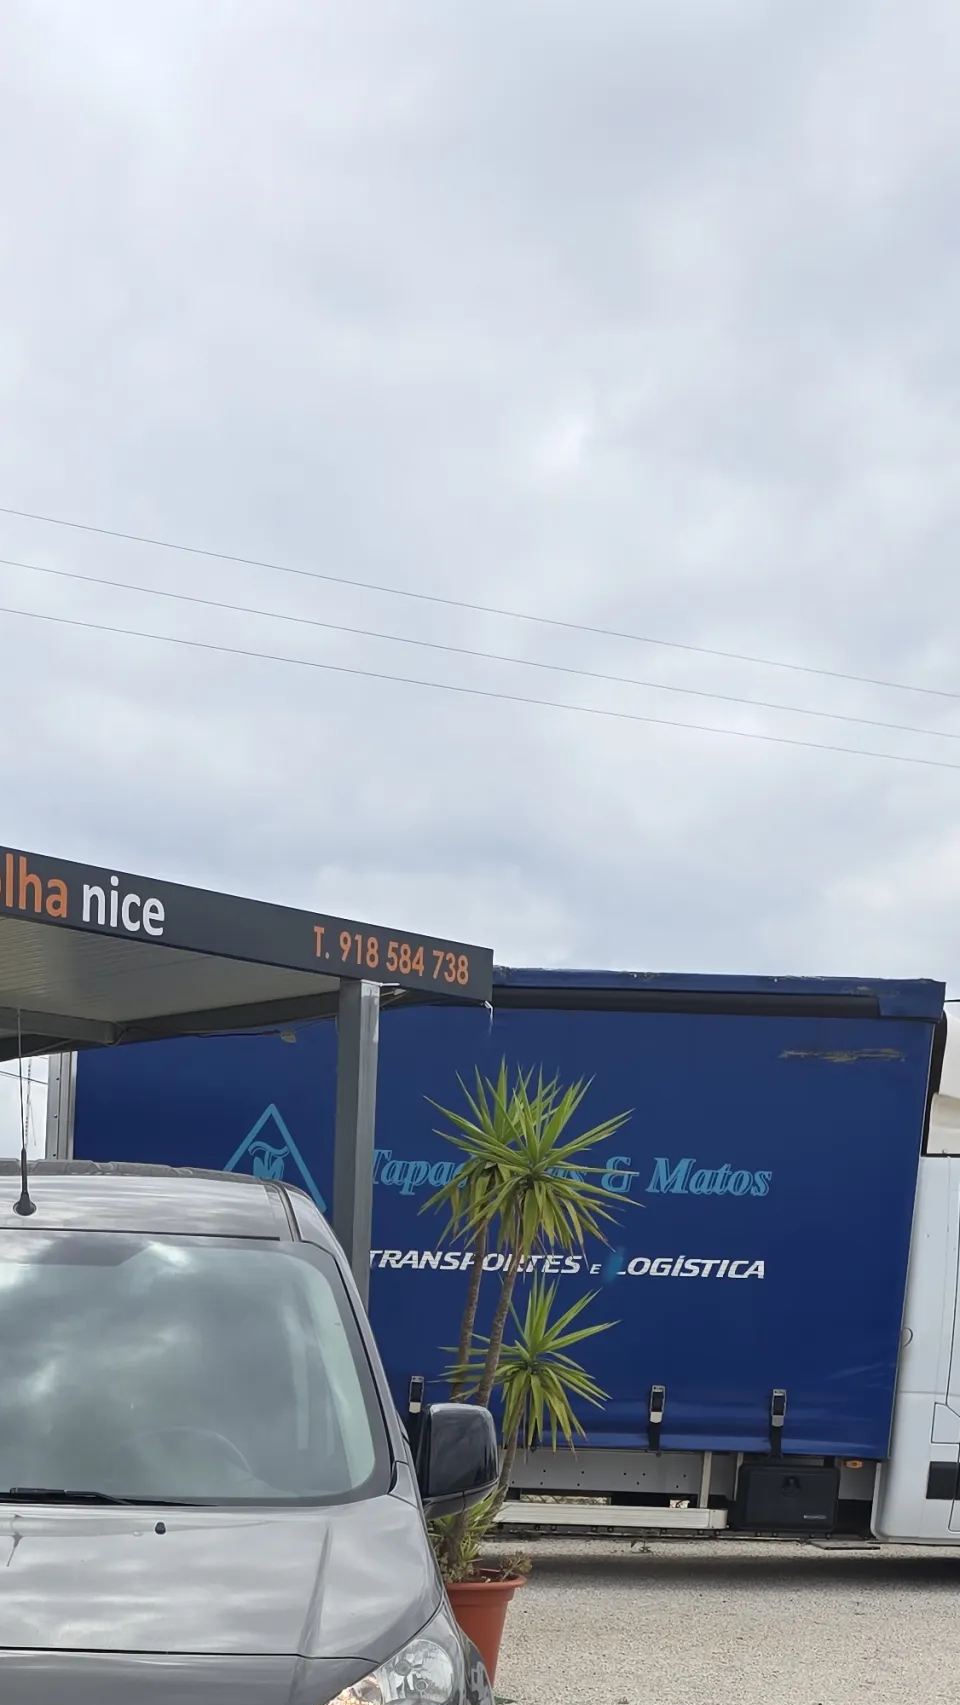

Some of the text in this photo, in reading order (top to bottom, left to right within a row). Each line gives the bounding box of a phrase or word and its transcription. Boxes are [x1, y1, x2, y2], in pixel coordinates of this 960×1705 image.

[82, 876, 166, 936] nice
[313, 925, 469, 986] T. 918 584 738
[601, 1155, 637, 1194] &
[646, 1157, 773, 1197] Matos
